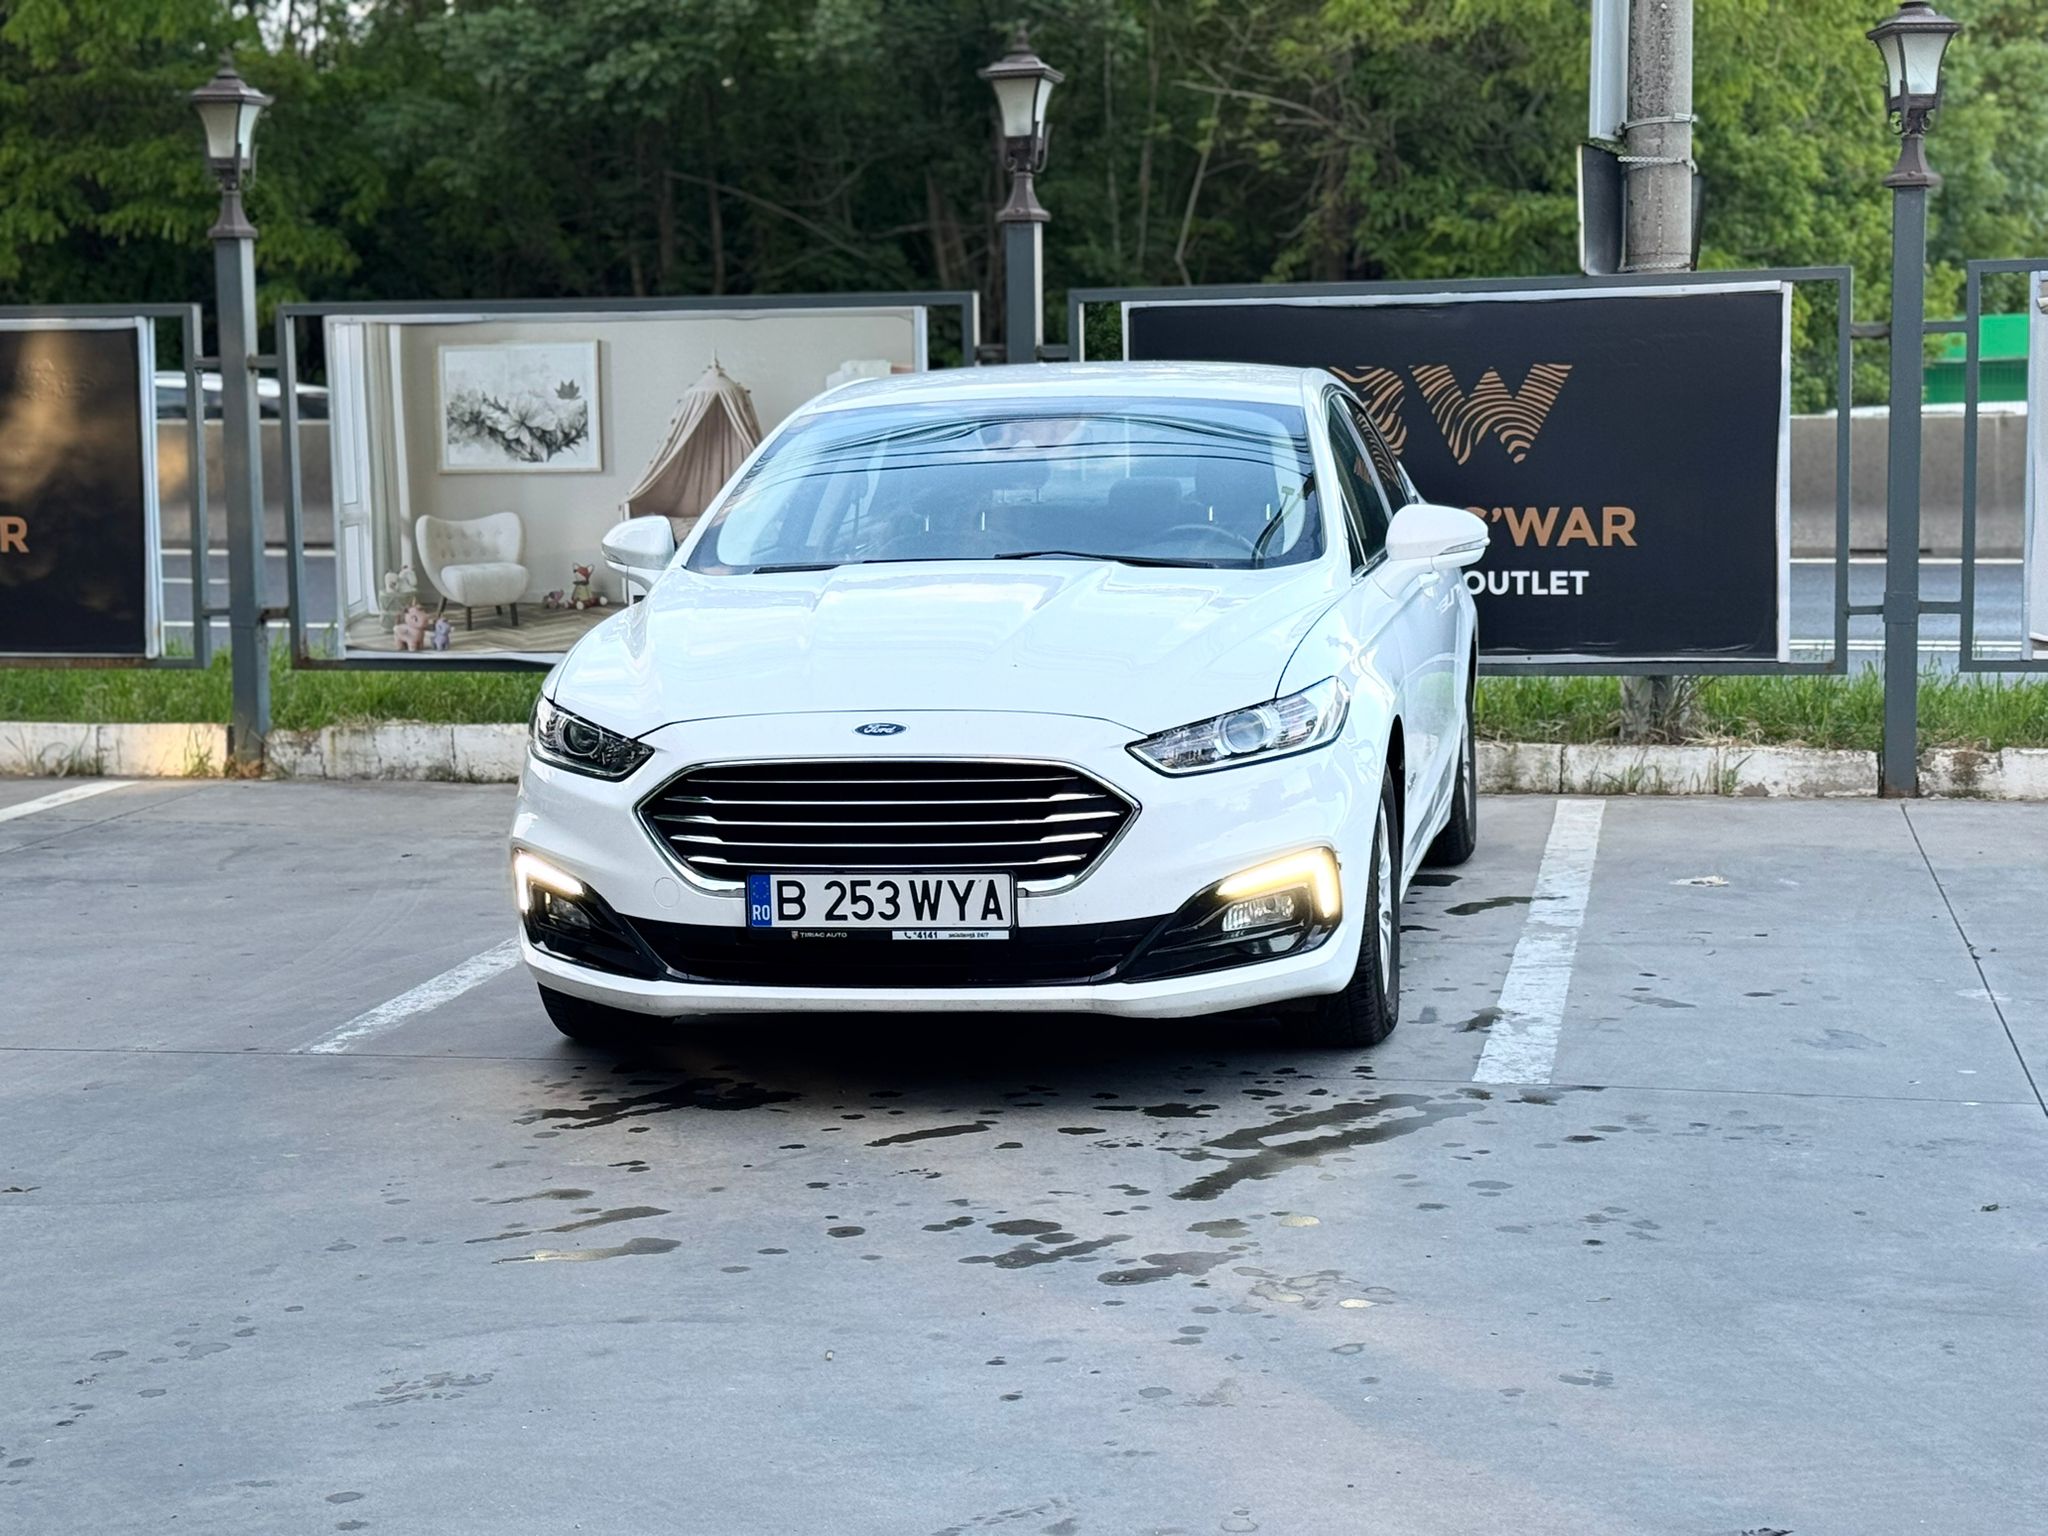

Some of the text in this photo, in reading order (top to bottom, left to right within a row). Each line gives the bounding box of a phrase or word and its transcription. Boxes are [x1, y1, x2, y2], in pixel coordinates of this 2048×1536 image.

[1464, 506, 1638, 548] 'WAR
[1463, 570, 1590, 595] OUTLET
[863, 724, 897, 734] Ford
[752, 904, 771, 921] RO
[776, 879, 1004, 921] B 253 WYA
